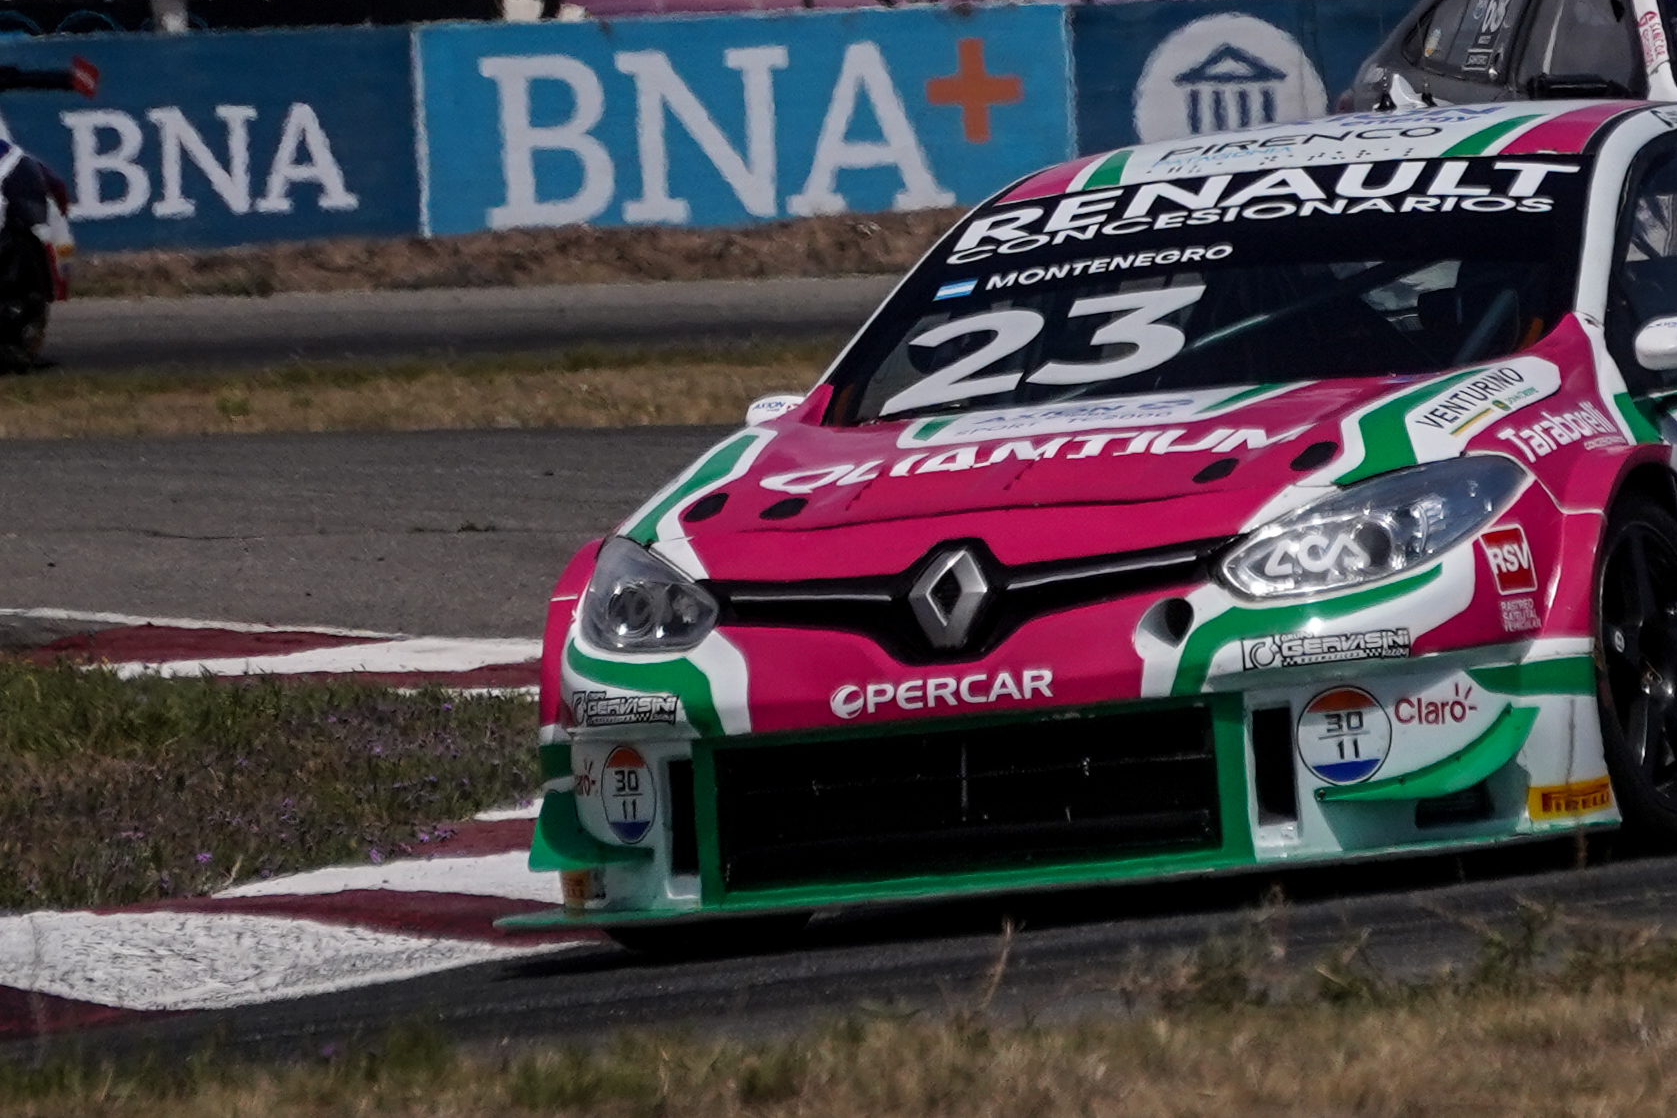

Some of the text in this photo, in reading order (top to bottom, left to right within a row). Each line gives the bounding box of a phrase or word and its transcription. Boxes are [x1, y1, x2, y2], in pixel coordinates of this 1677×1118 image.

[1159, 126, 1443, 162] PIRENCO
[60, 102, 359, 222] BNA
[953, 160, 1580, 252] RENAULT
[946, 195, 1553, 265] CONCESIONARIOS
[985, 244, 1234, 291] MONTENEGRO
[880, 284, 1207, 420] 23
[1415, 366, 1525, 430] VENTURINO
[1488, 541, 1530, 575] RSV
[1281, 630, 1410, 657] GERVASINI
[1325, 710, 1365, 732] 30
[1395, 694, 1467, 726] Claro
[1336, 738, 1361, 761] 11
[614, 769, 639, 793] 30
[622, 798, 637, 821] 11
